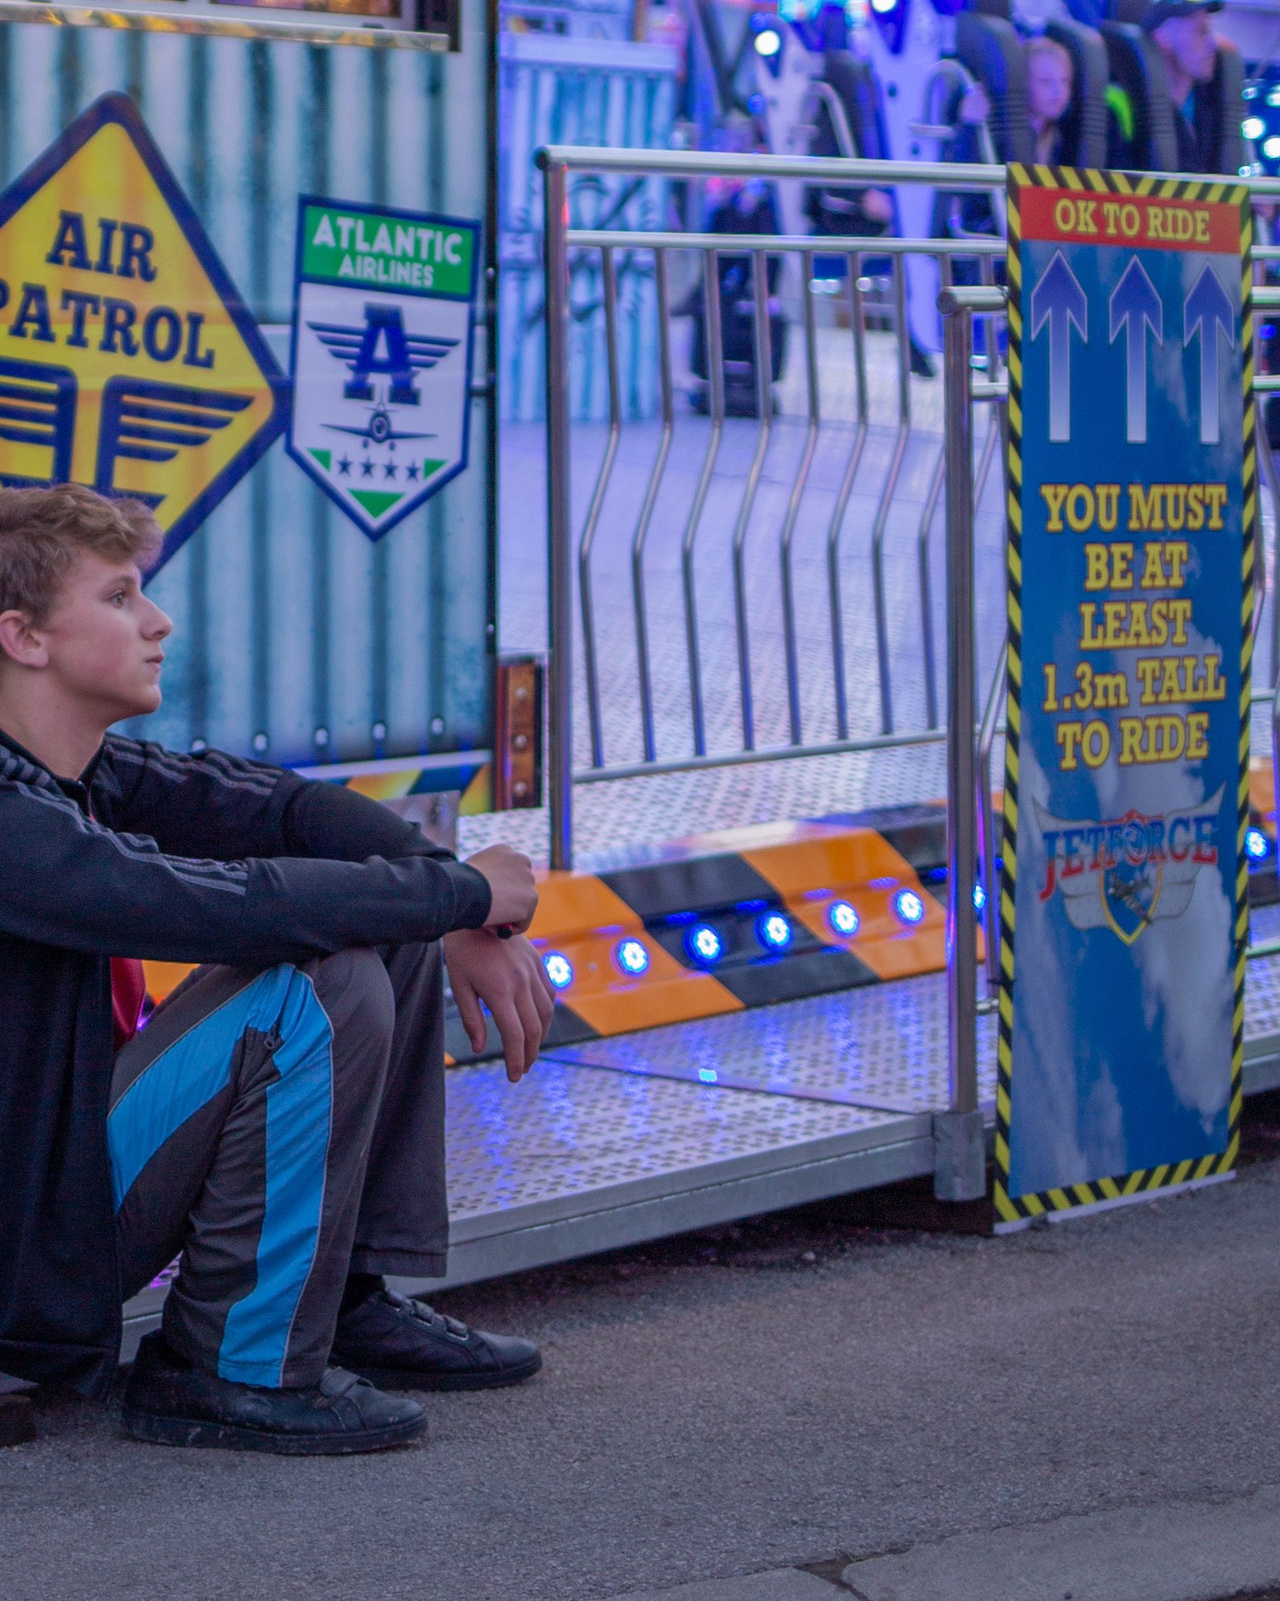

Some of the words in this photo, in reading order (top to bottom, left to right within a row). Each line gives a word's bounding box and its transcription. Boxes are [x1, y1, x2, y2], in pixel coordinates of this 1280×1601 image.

[45, 209, 158, 283] AIR
[312, 214, 464, 266] ATLANTIC
[1054, 198, 1098, 235] OK
[1103, 202, 1141, 238] TO
[1146, 206, 1211, 243] RIDE
[337, 253, 435, 288] AIRLINES
[1040, 483, 1120, 533] YOU
[1127, 483, 1228, 532] MUST
[1083, 542, 1134, 591] BE
[1140, 541, 1188, 590] AT
[1079, 598, 1192, 650] LEAST
[1042, 661, 1129, 712] 1.3m
[1137, 654, 1226, 705] TALL
[1056, 719, 1111, 771] TO
[1118, 712, 1210, 766] RIDE
[1039, 814, 1219, 900] JETFORCE
